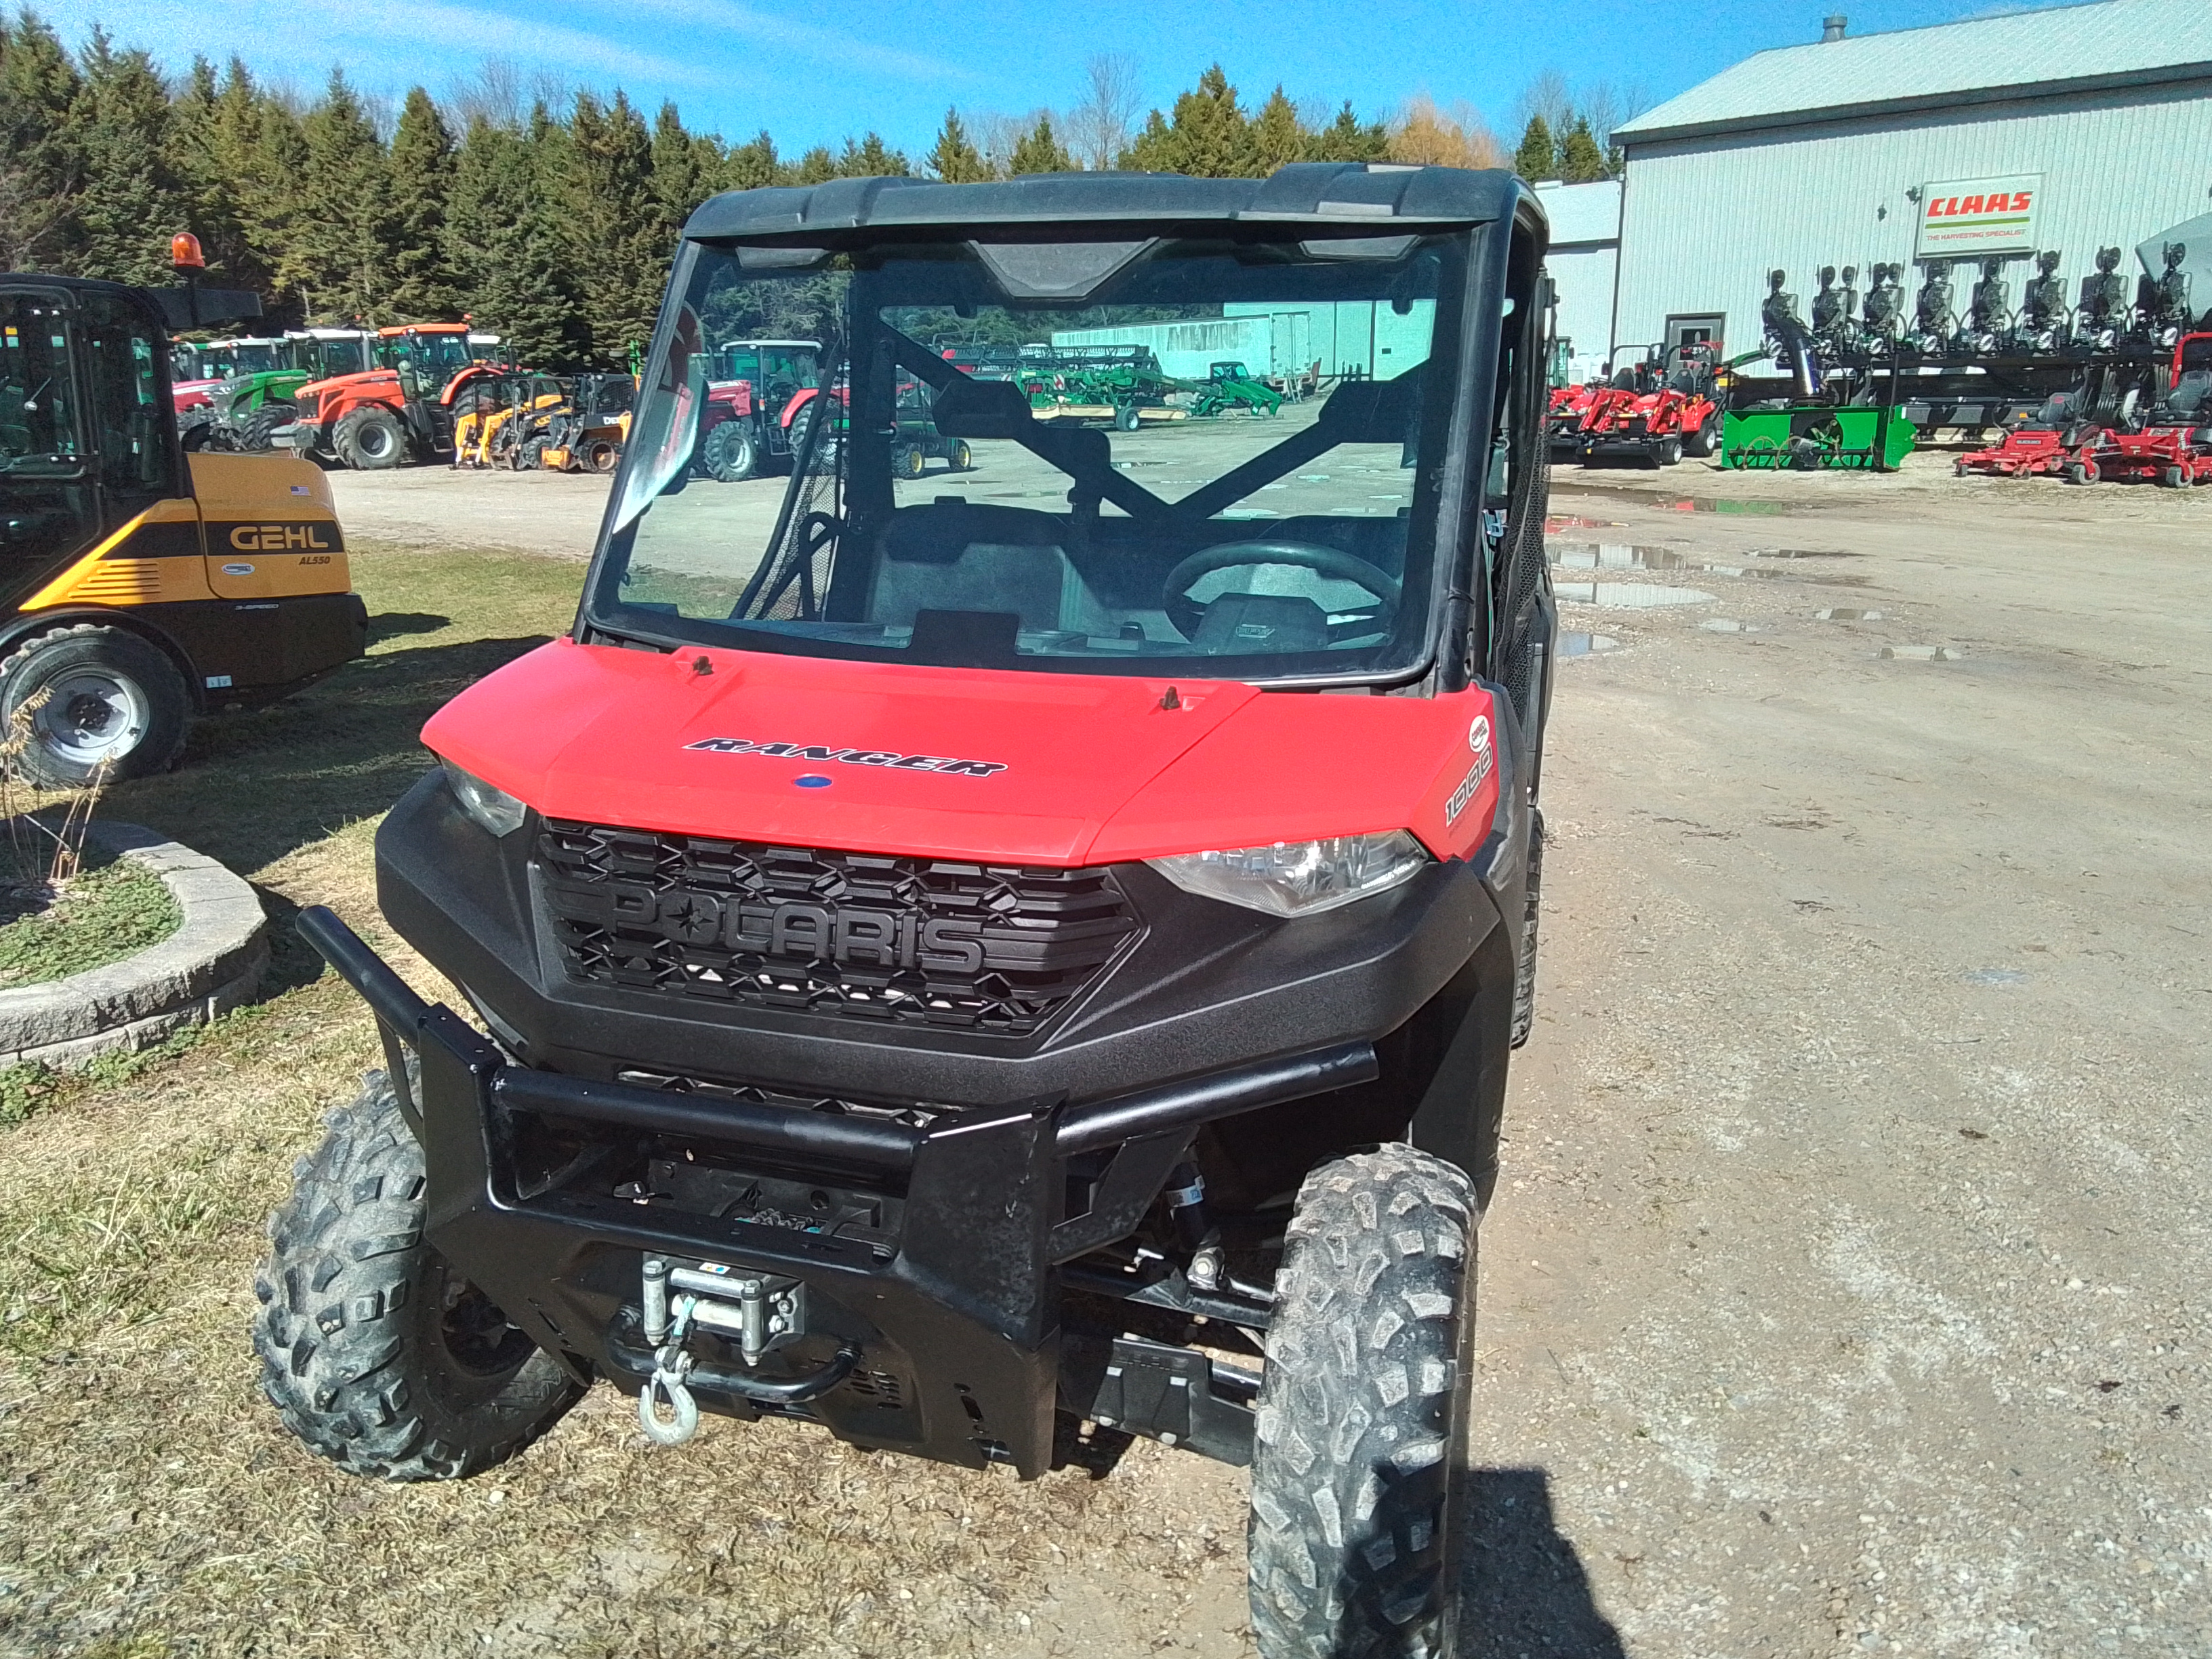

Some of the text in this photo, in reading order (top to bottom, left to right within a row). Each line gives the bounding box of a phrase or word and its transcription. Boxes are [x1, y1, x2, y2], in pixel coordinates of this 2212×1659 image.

[1927, 191, 2033, 218] CLAAS
[1941, 232, 1984, 240] HARVESTING
[1986, 229, 2026, 237] SPECIALIST
[230, 525, 329, 550] GEHL
[299, 556, 331, 565] AL550
[681, 737, 1008, 777] RANGER
[1445, 741, 1493, 828] 1000
[609, 884, 987, 973] POLARIS
